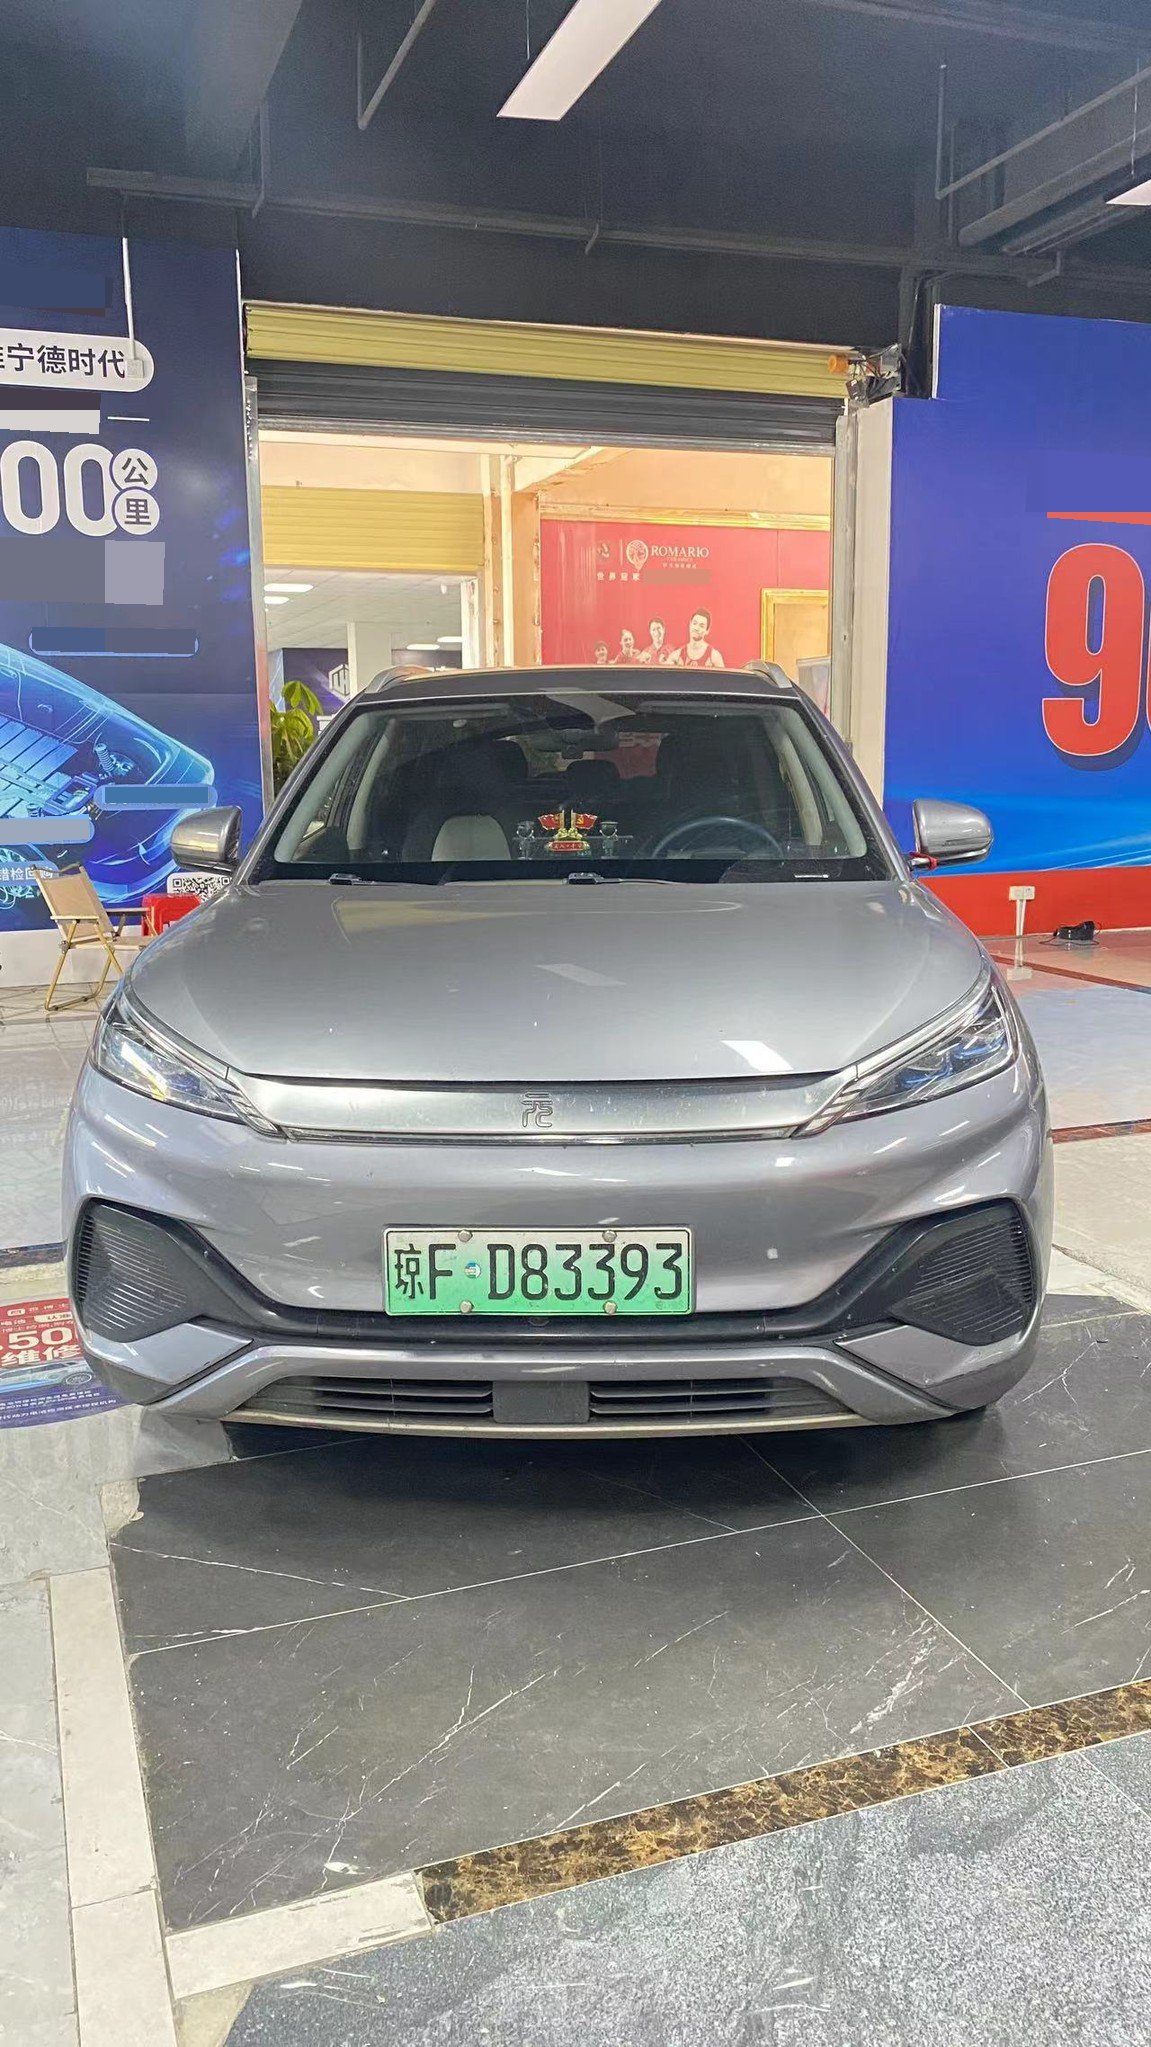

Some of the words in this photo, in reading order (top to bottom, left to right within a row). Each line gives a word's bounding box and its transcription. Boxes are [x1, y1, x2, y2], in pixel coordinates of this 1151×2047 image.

[122, 457, 151, 526] 公里
[651, 545, 710, 558] ROMARIO
[1042, 543, 1151, 757] 9
